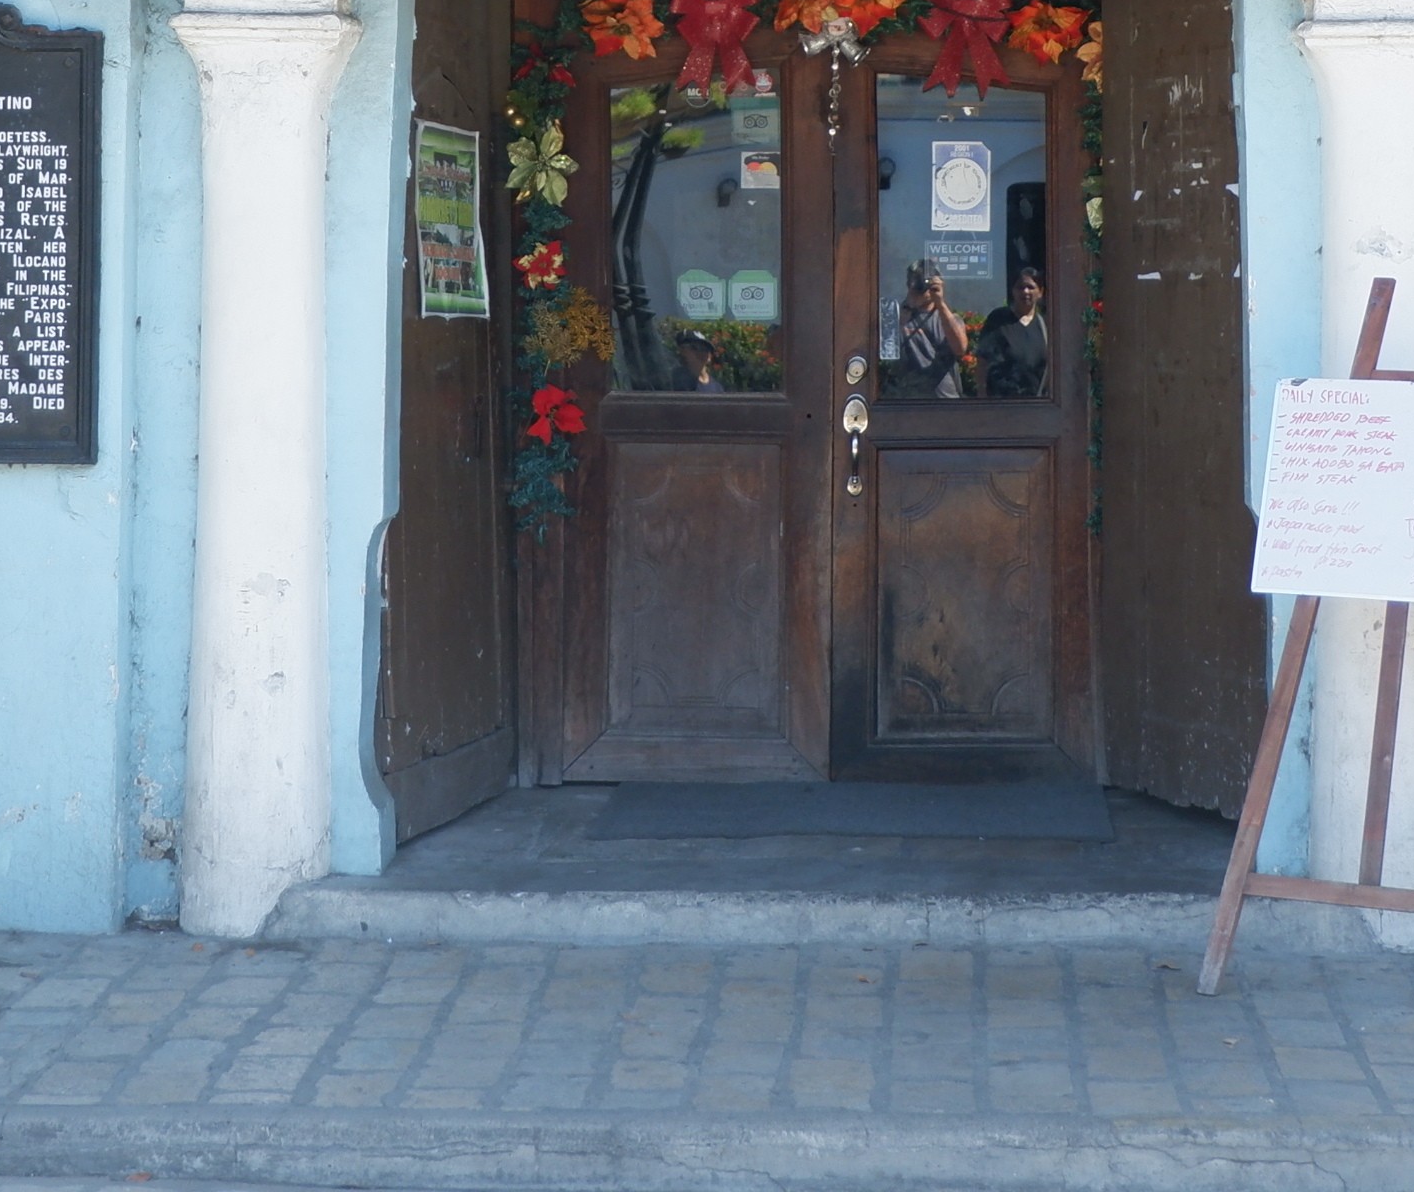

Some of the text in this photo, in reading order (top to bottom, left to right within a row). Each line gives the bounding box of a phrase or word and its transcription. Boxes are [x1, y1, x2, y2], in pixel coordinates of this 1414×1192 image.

[16, 156, 43, 171] SUR
[54, 158, 68, 171] 19
[8, 172, 25, 185] OF
[38, 170, 73, 185] MAR-
[20, 184, 68, 199] ISABEL
[16, 200, 33, 213] OF
[43, 200, 67, 213] THE
[20, 212, 69, 227] REYES.
[53, 225, 65, 240] A
[42, 241, 67, 254] HER
[930, 244, 987, 254] WELCOME
[12, 253, 67, 268] ILOCANO
[15, 269, 28, 282] IN
[41, 269, 67, 282] THE
[11, 325, 21, 338] A
[36, 325, 65, 338] LIST
[16, 339, 71, 352] APPEAR-
[28, 352, 70, 367] INTER-
[37, 368, 64, 381] DES
[7, 380, 65, 396] MADAME
[32, 395, 65, 411] DIED
